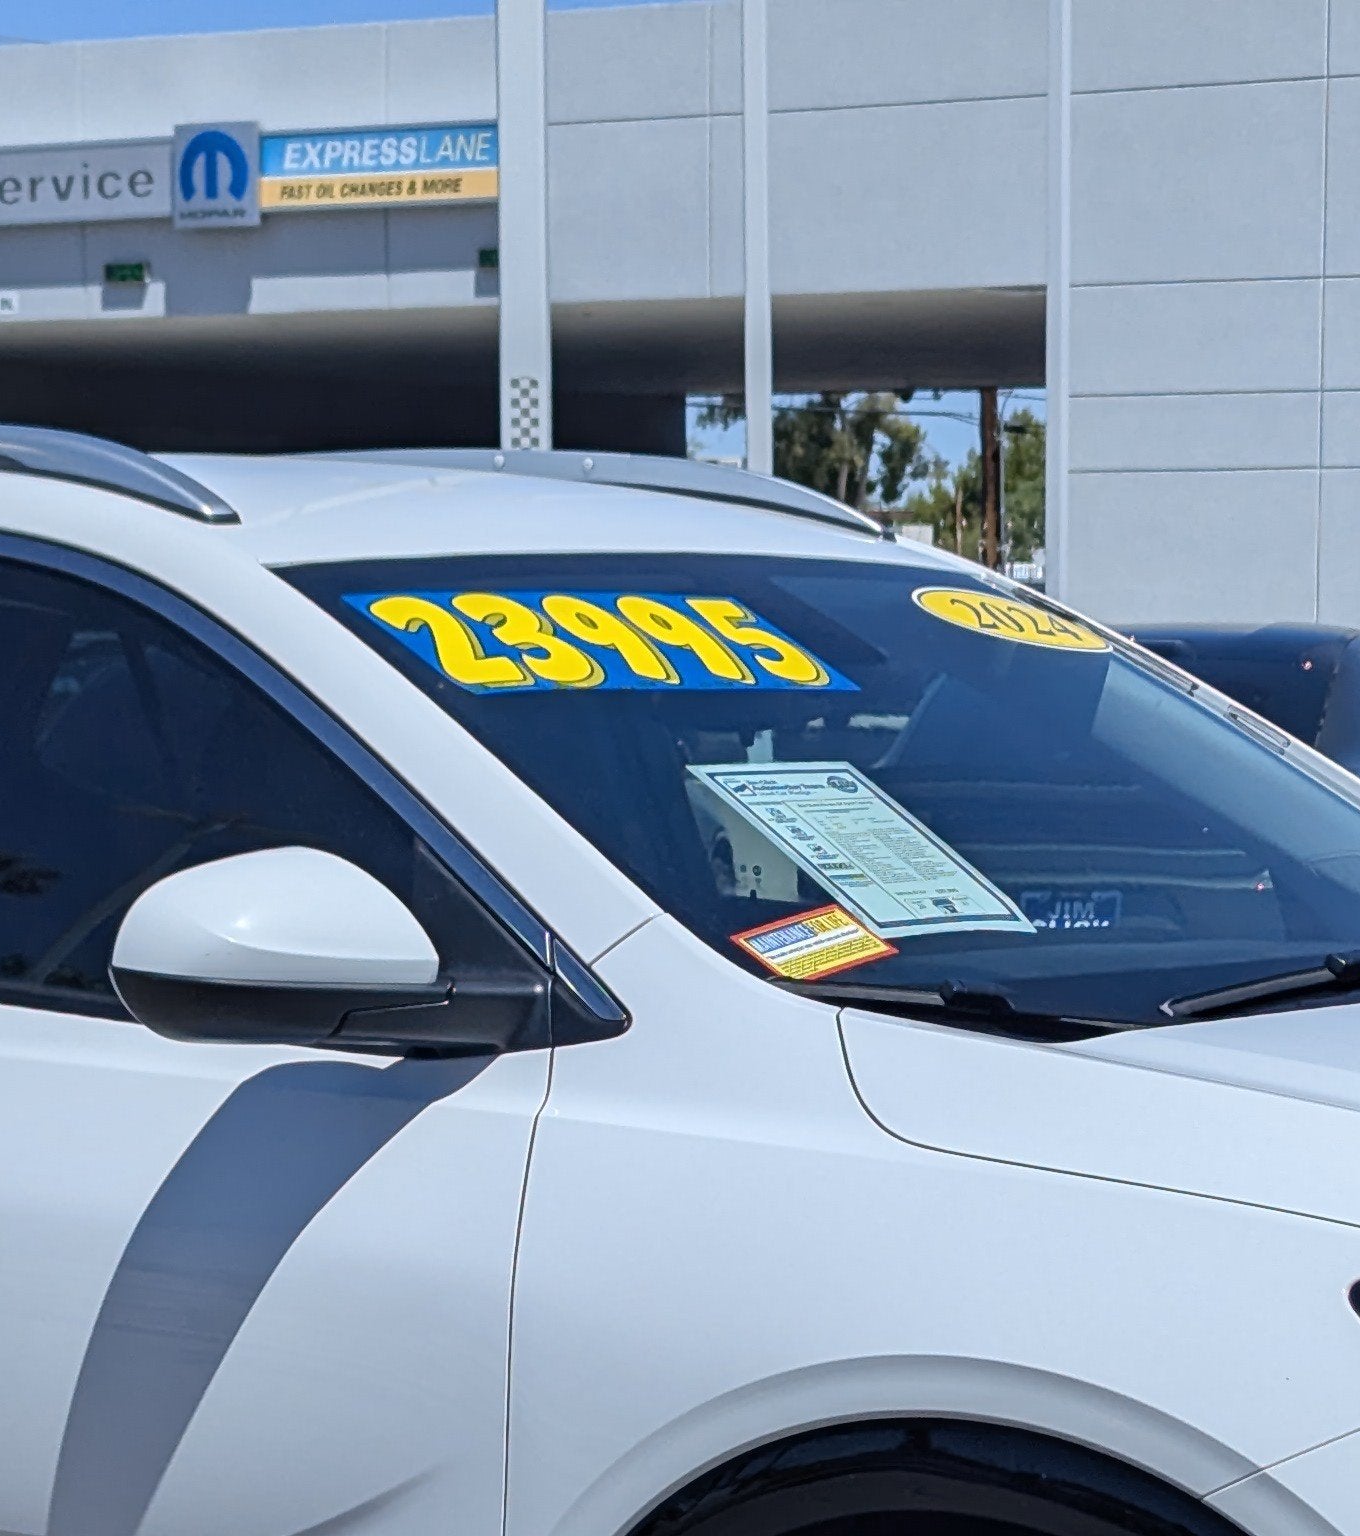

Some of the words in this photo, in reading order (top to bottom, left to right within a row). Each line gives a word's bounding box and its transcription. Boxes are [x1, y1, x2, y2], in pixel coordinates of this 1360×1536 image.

[280, 184, 313, 200] FAST
[316, 182, 335, 199] OIL
[340, 180, 403, 198] CHANGES
[421, 177, 463, 194] MORE
[949, 597, 1084, 642] 2024
[368, 590, 831, 688] 23995
[1048, 900, 1096, 919] JIM
